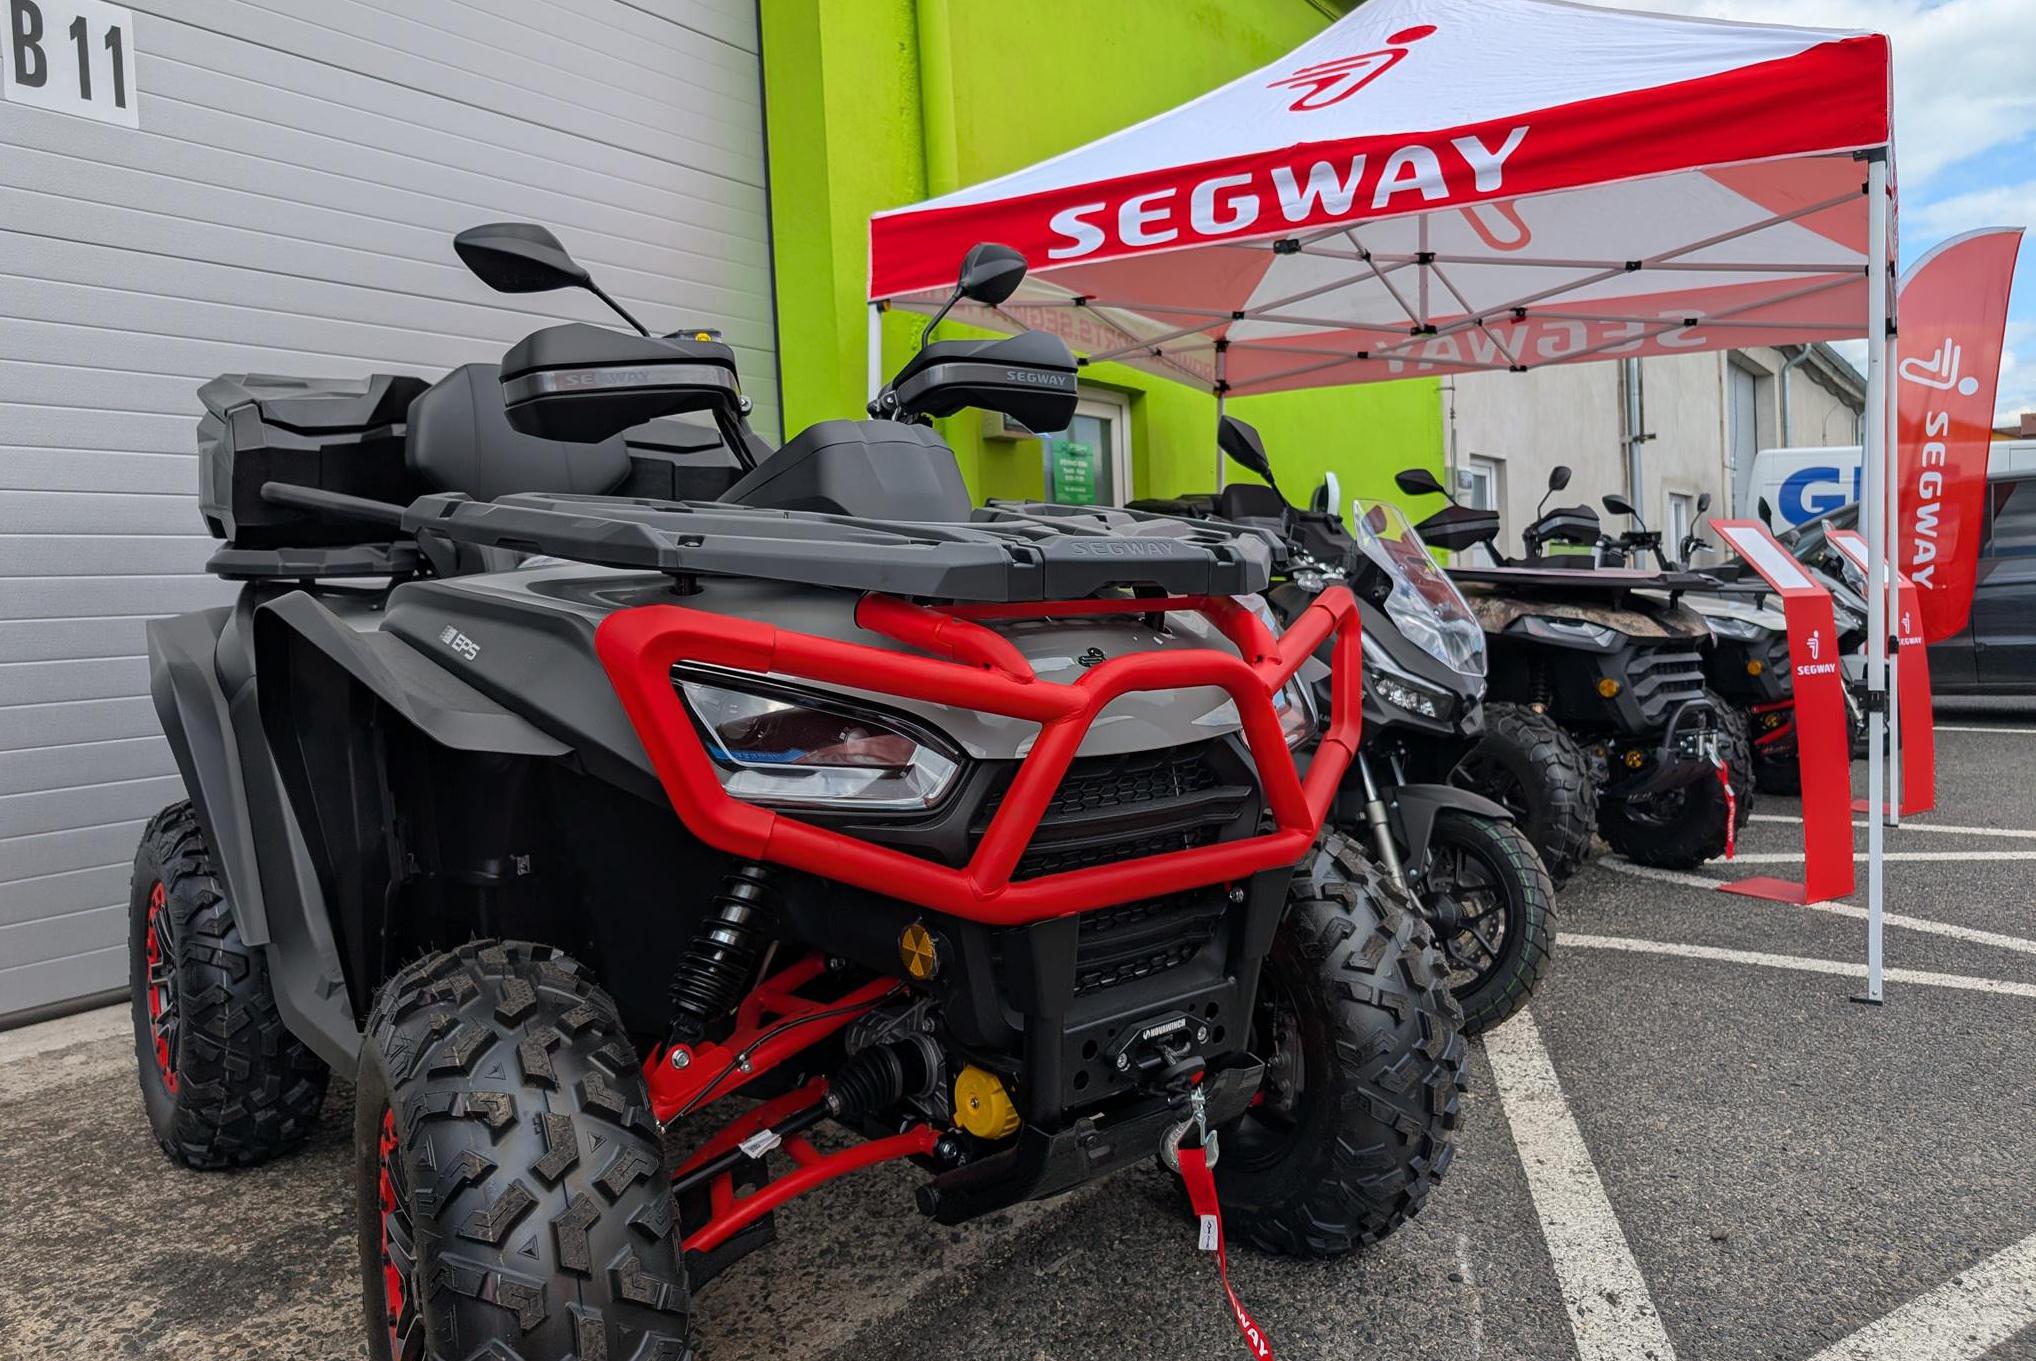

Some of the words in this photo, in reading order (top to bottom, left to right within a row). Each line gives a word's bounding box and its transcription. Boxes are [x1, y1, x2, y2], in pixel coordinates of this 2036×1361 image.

[1047, 125, 1529, 260] SEGWAY
[564, 371, 651, 386] SEWAY
[1007, 370, 1067, 386] SEGWAY
[1911, 410, 1949, 590] SEGWAY
[1071, 541, 1174, 556] SEGWAY
[451, 633, 481, 661] EPS
[1898, 636, 1922, 647] EGWAY
[1796, 663, 1836, 676] SEGWAY
